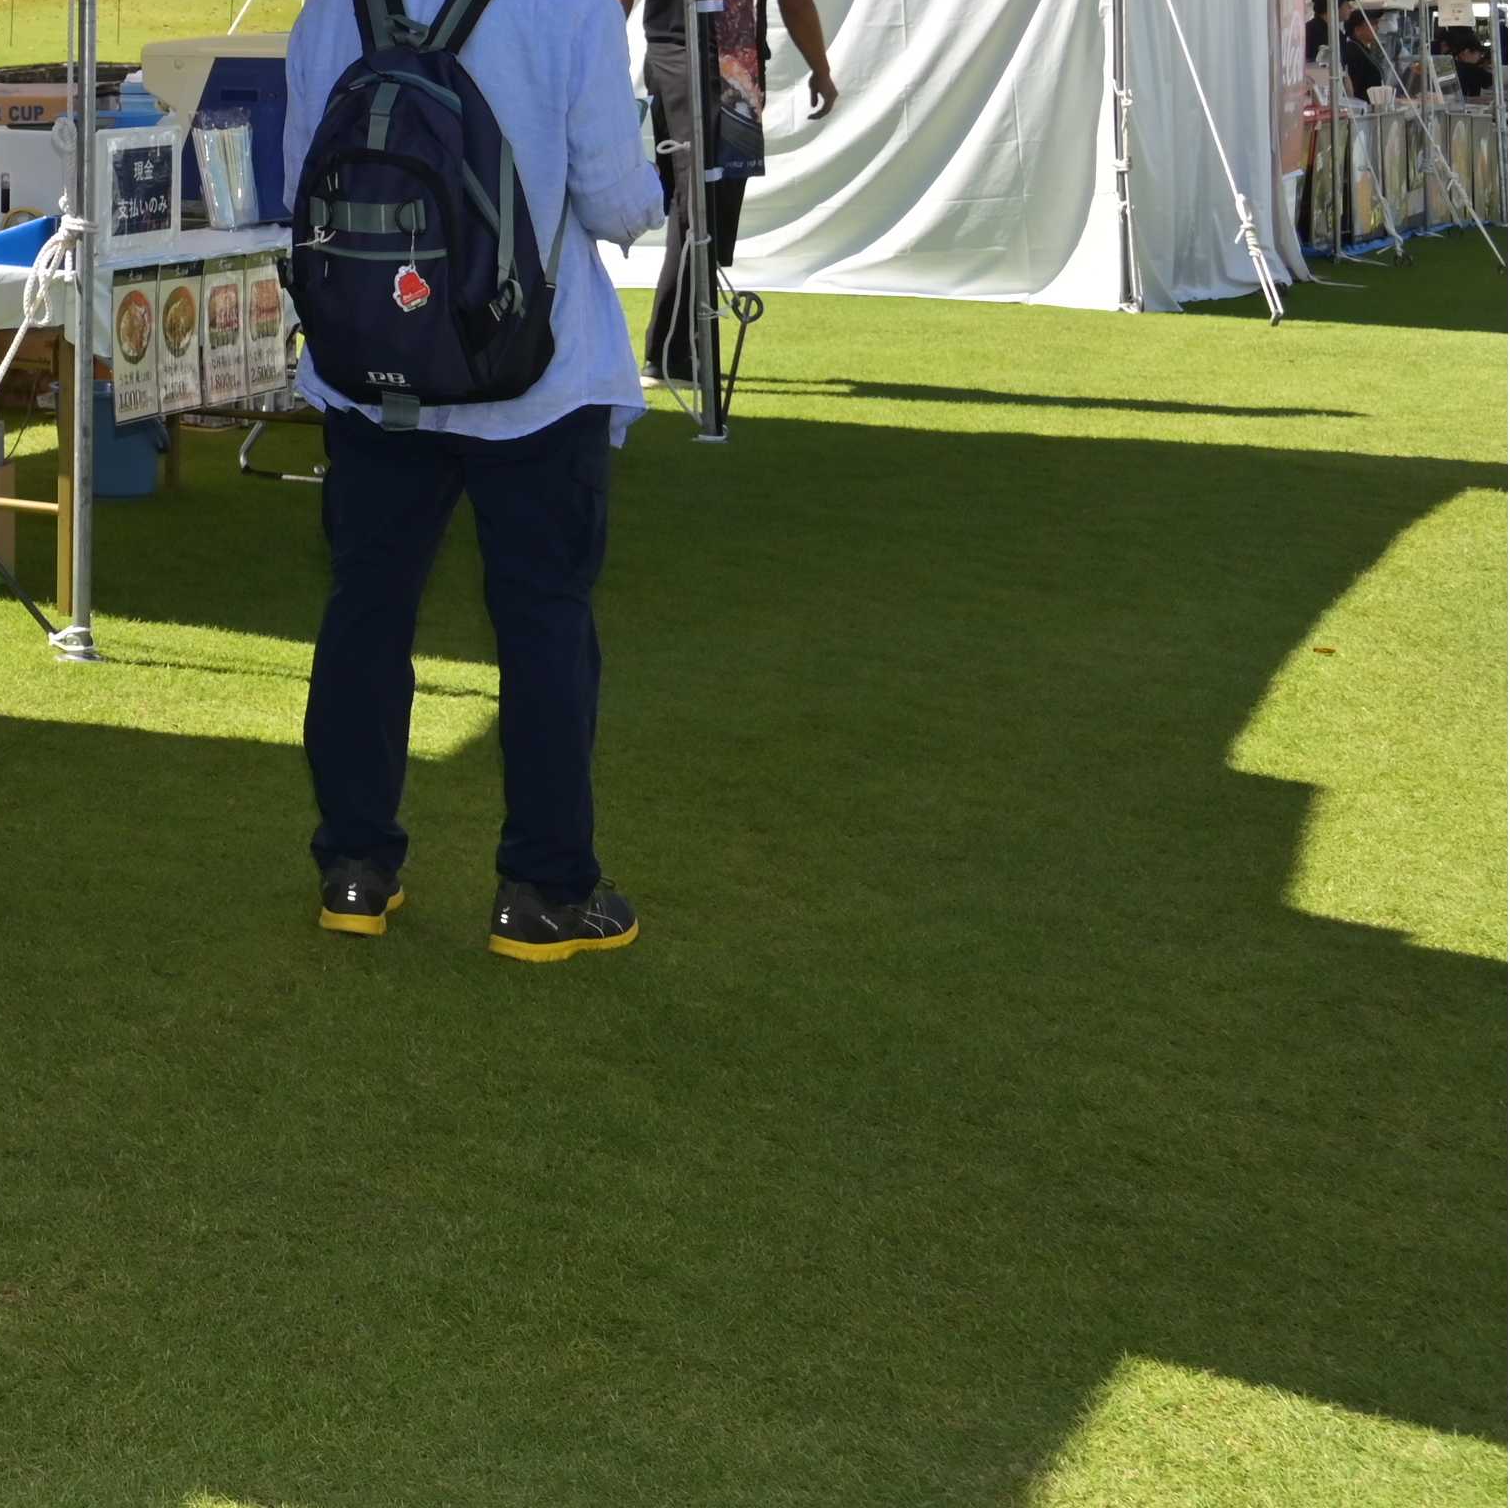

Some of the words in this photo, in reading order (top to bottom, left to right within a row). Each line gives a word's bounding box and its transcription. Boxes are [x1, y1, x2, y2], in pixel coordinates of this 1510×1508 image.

[9, 106, 44, 121] CUP
[133, 161, 154, 181] 現金
[117, 194, 169, 220] 支払いのみ
